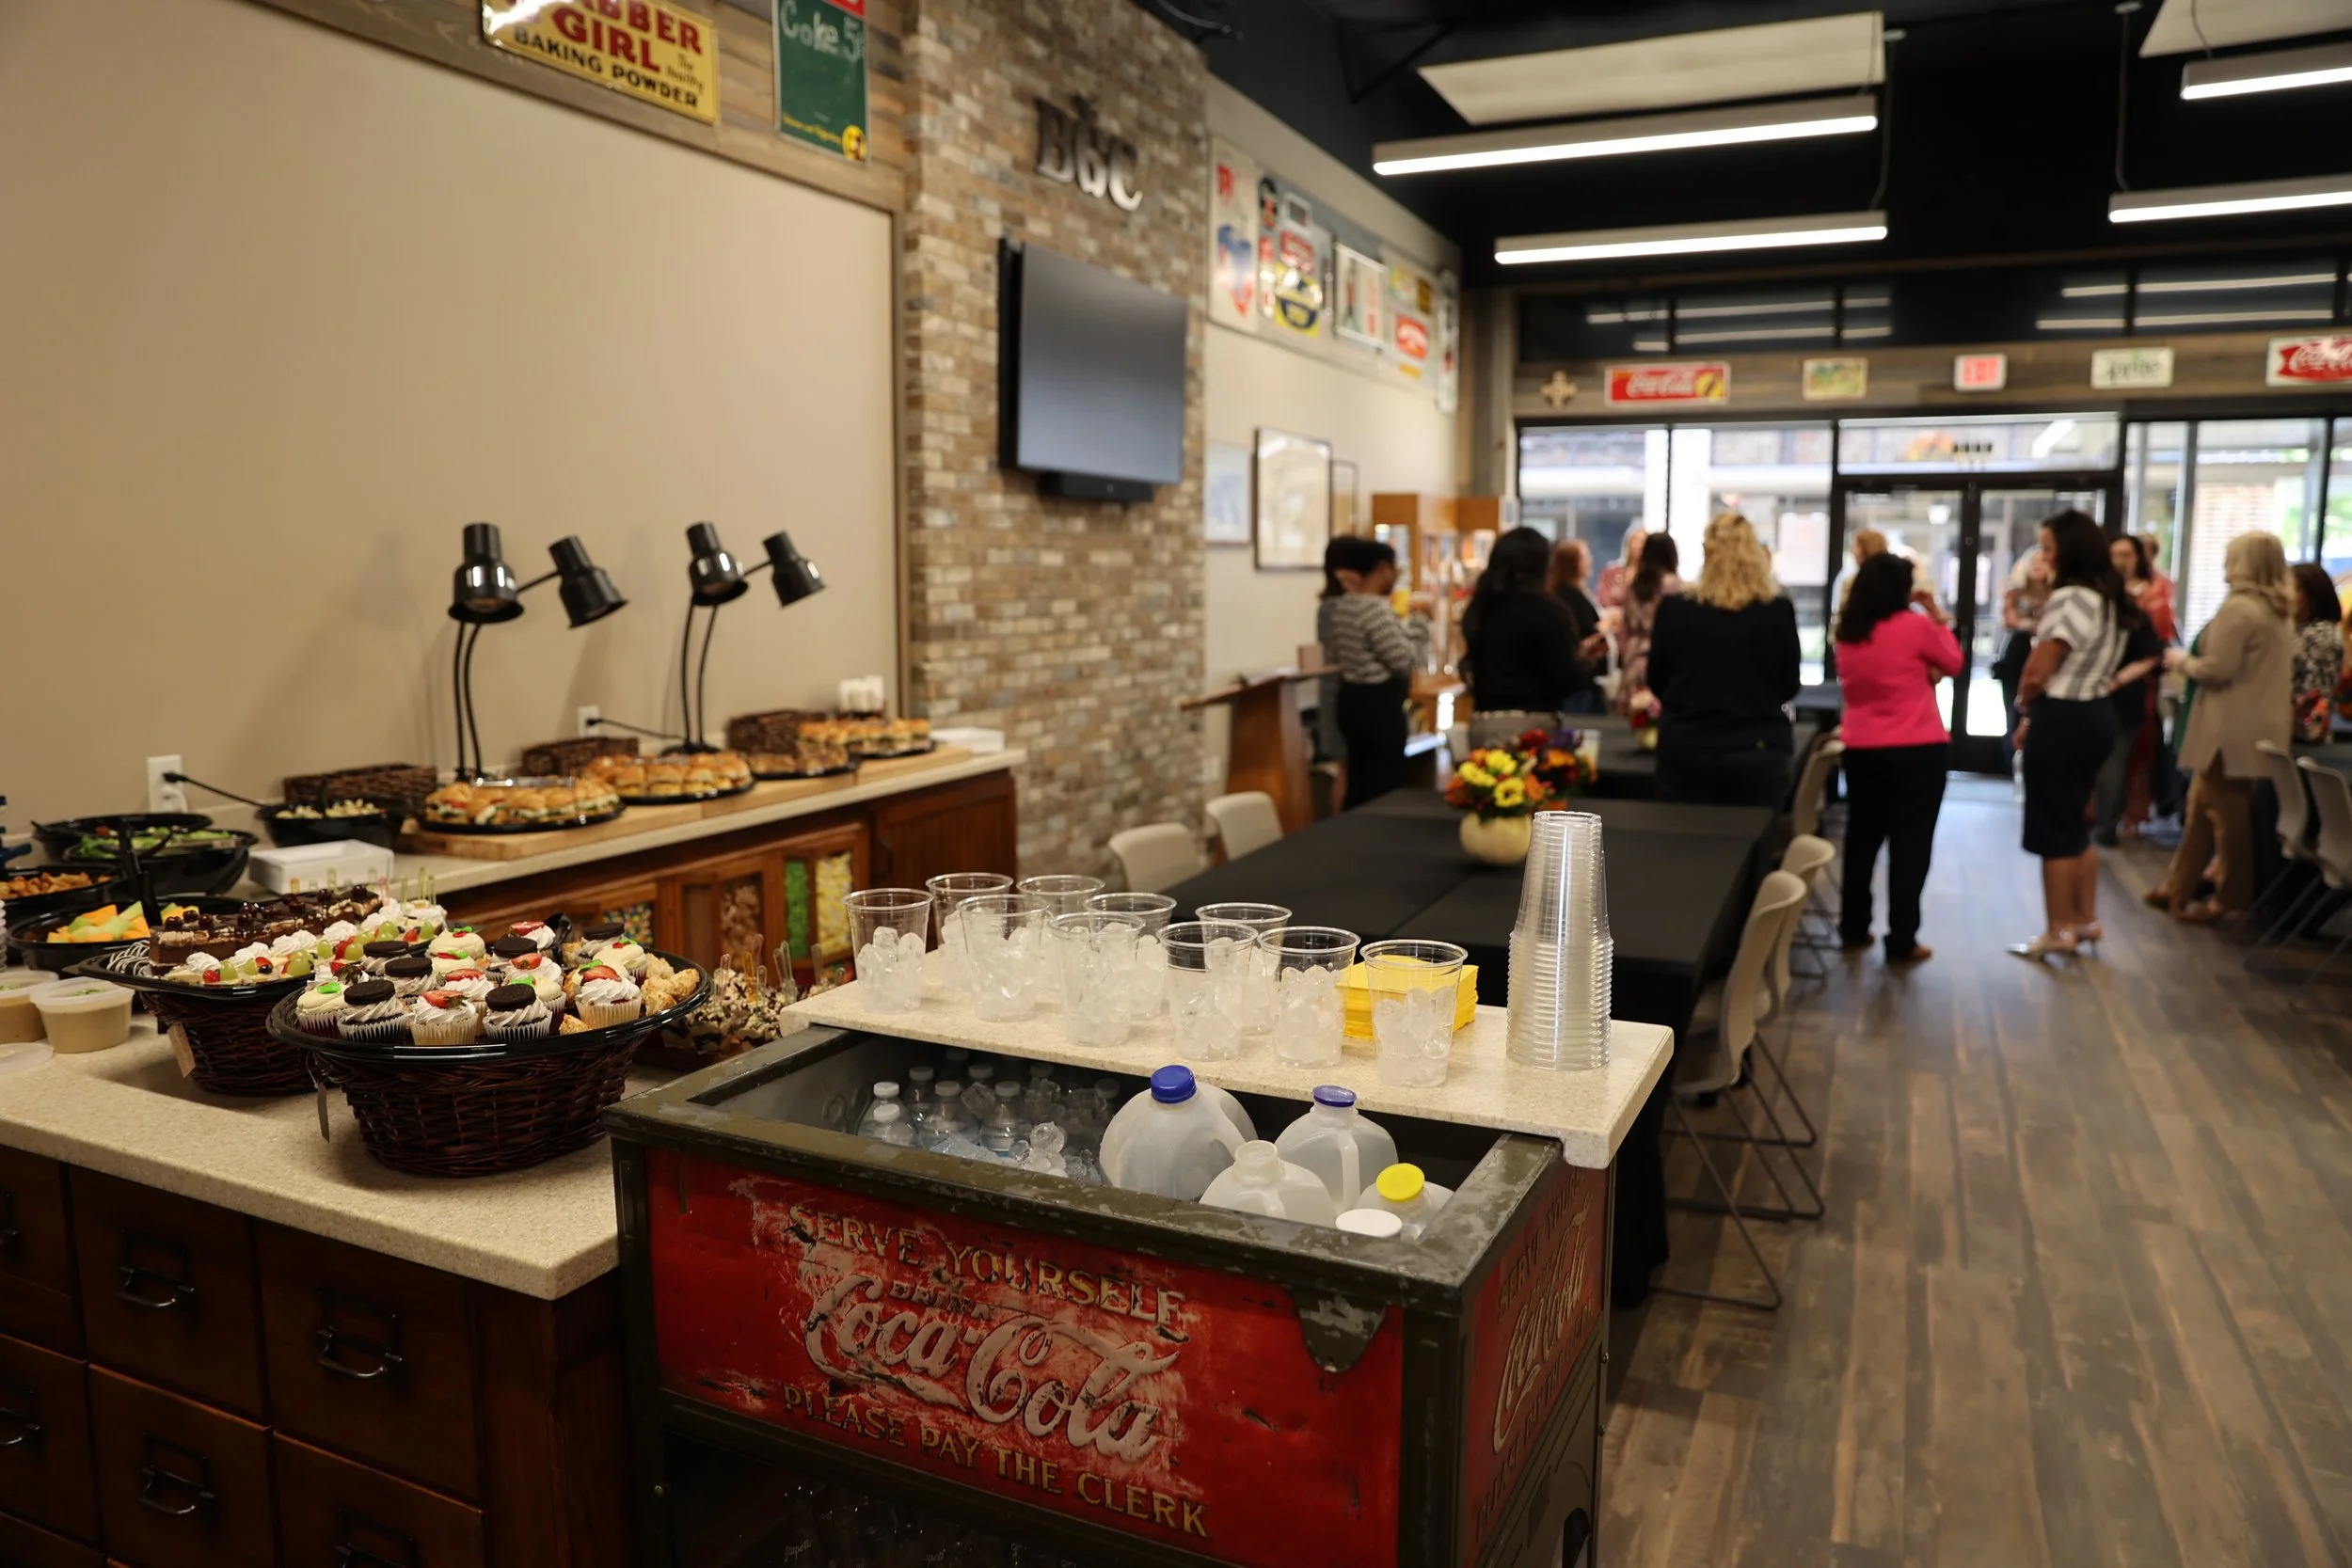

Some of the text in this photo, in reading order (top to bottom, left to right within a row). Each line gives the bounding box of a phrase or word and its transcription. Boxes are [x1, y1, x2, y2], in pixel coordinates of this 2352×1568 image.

[514, 25, 699, 108] BAKING POWDER
[552, 7, 662, 72] GIRL
[780, 0, 840, 55] Coke
[789, 1203, 1186, 1327] SERVE YOURSELF
[1493, 1191, 1592, 1455] Coca-Cola
[803, 1274, 1180, 1464] Coca-Cola
[784, 1385, 1211, 1539] PLEASE PAY THE CLERK
